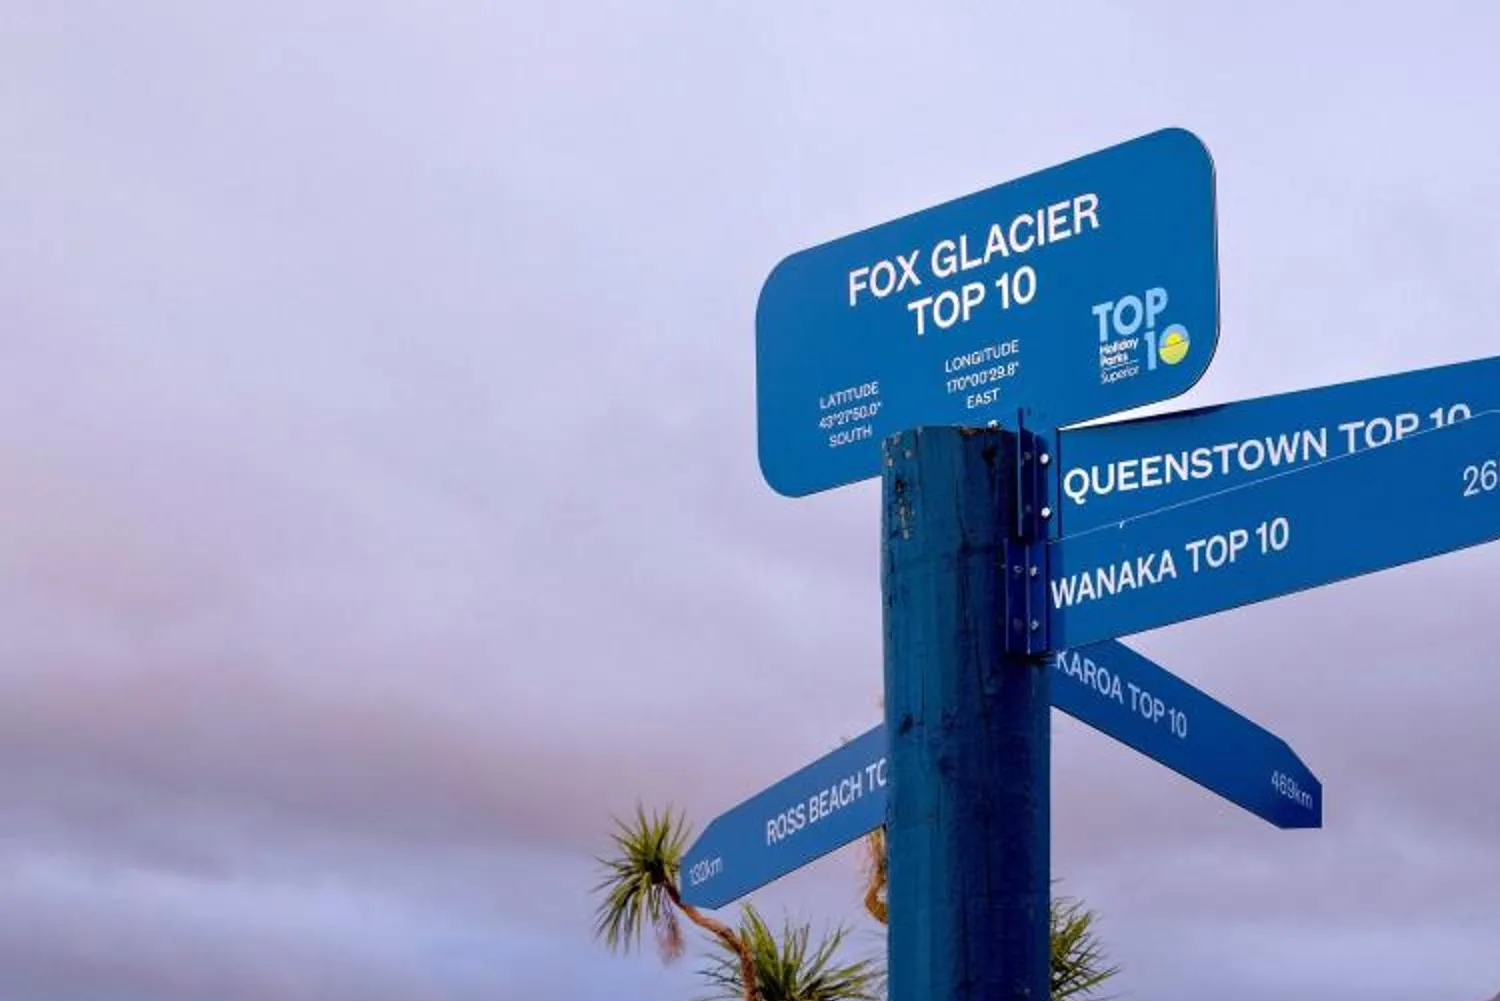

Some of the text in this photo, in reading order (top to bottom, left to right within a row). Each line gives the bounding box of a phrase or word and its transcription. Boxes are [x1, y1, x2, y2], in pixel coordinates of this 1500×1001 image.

[849, 193, 1099, 307] FOX GLACIER
[908, 265, 1037, 335] TOP 10
[1092, 287, 1168, 342] TOP
[945, 339, 1019, 373] LONGITUDE
[1143, 323, 1191, 371] 10
[819, 381, 880, 409] LATITUDE
[967, 388, 1001, 409] EAST
[1100, 366, 1139, 384] Superior
[829, 424, 873, 448] SOUTH
[1063, 427, 1327, 504] QUEENSTOWN
[1338, 412, 1418, 453] TOP
[1051, 549, 1177, 609] WANAKA
[1186, 528, 1248, 573] TOP
[1256, 517, 1290, 554] 10
[1056, 649, 1124, 705] KAROA
[1128, 682, 1165, 724] TOP
[1169, 709, 1188, 739] 10
[766, 804, 806, 846] ROSS
[809, 772, 862, 824] BEACH
